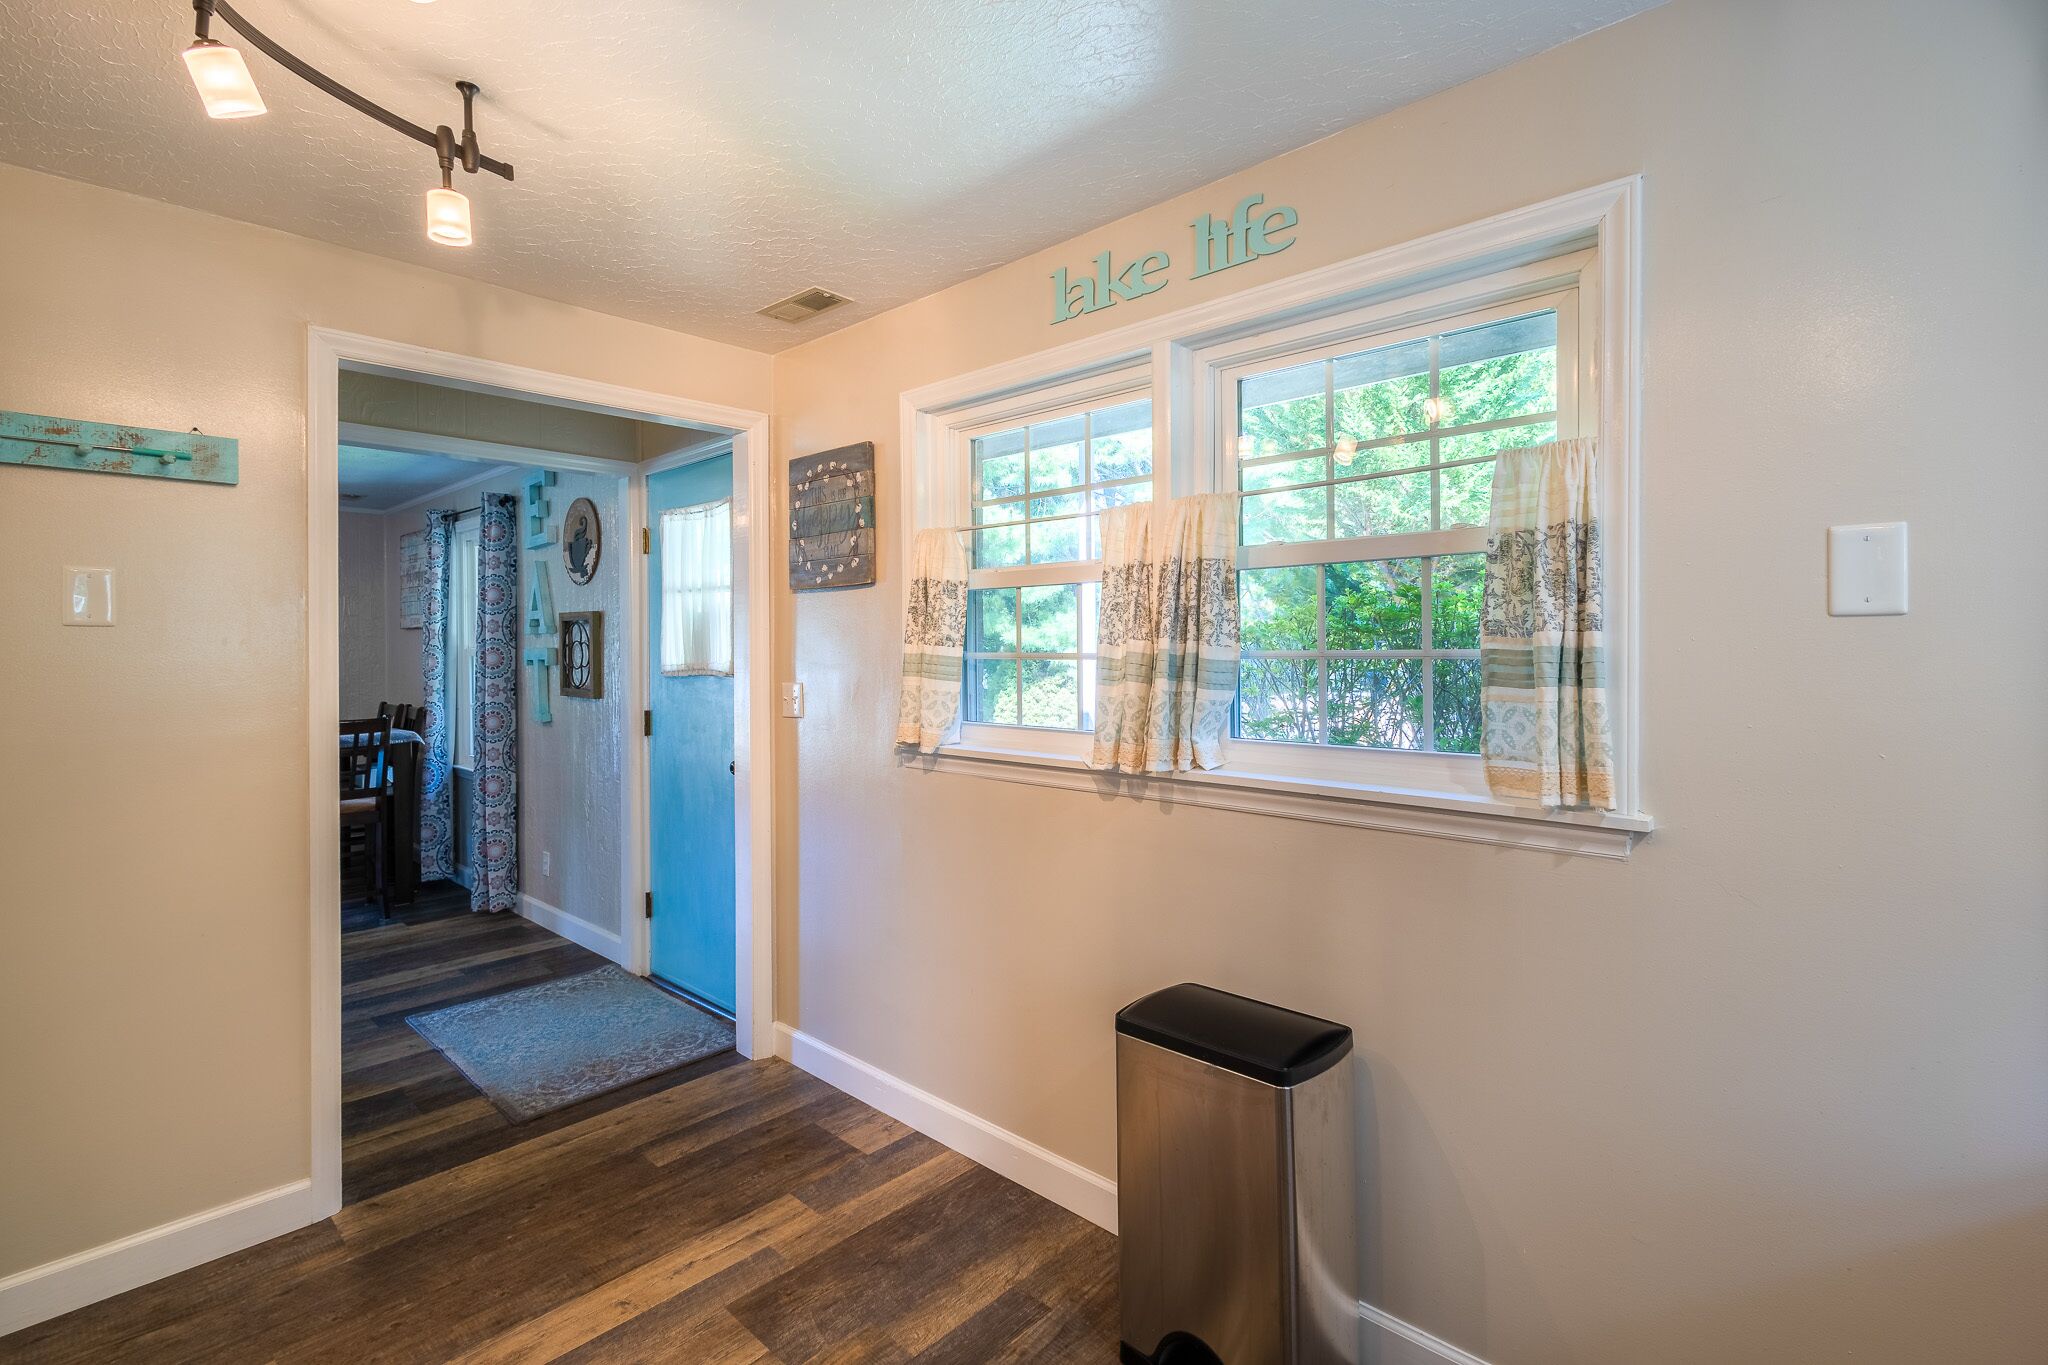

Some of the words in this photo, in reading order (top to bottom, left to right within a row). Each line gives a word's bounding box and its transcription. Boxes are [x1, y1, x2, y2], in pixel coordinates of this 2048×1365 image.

[1049, 251, 1170, 325] lake
[1189, 193, 1297, 280] life
[524, 469, 558, 723] EAT
